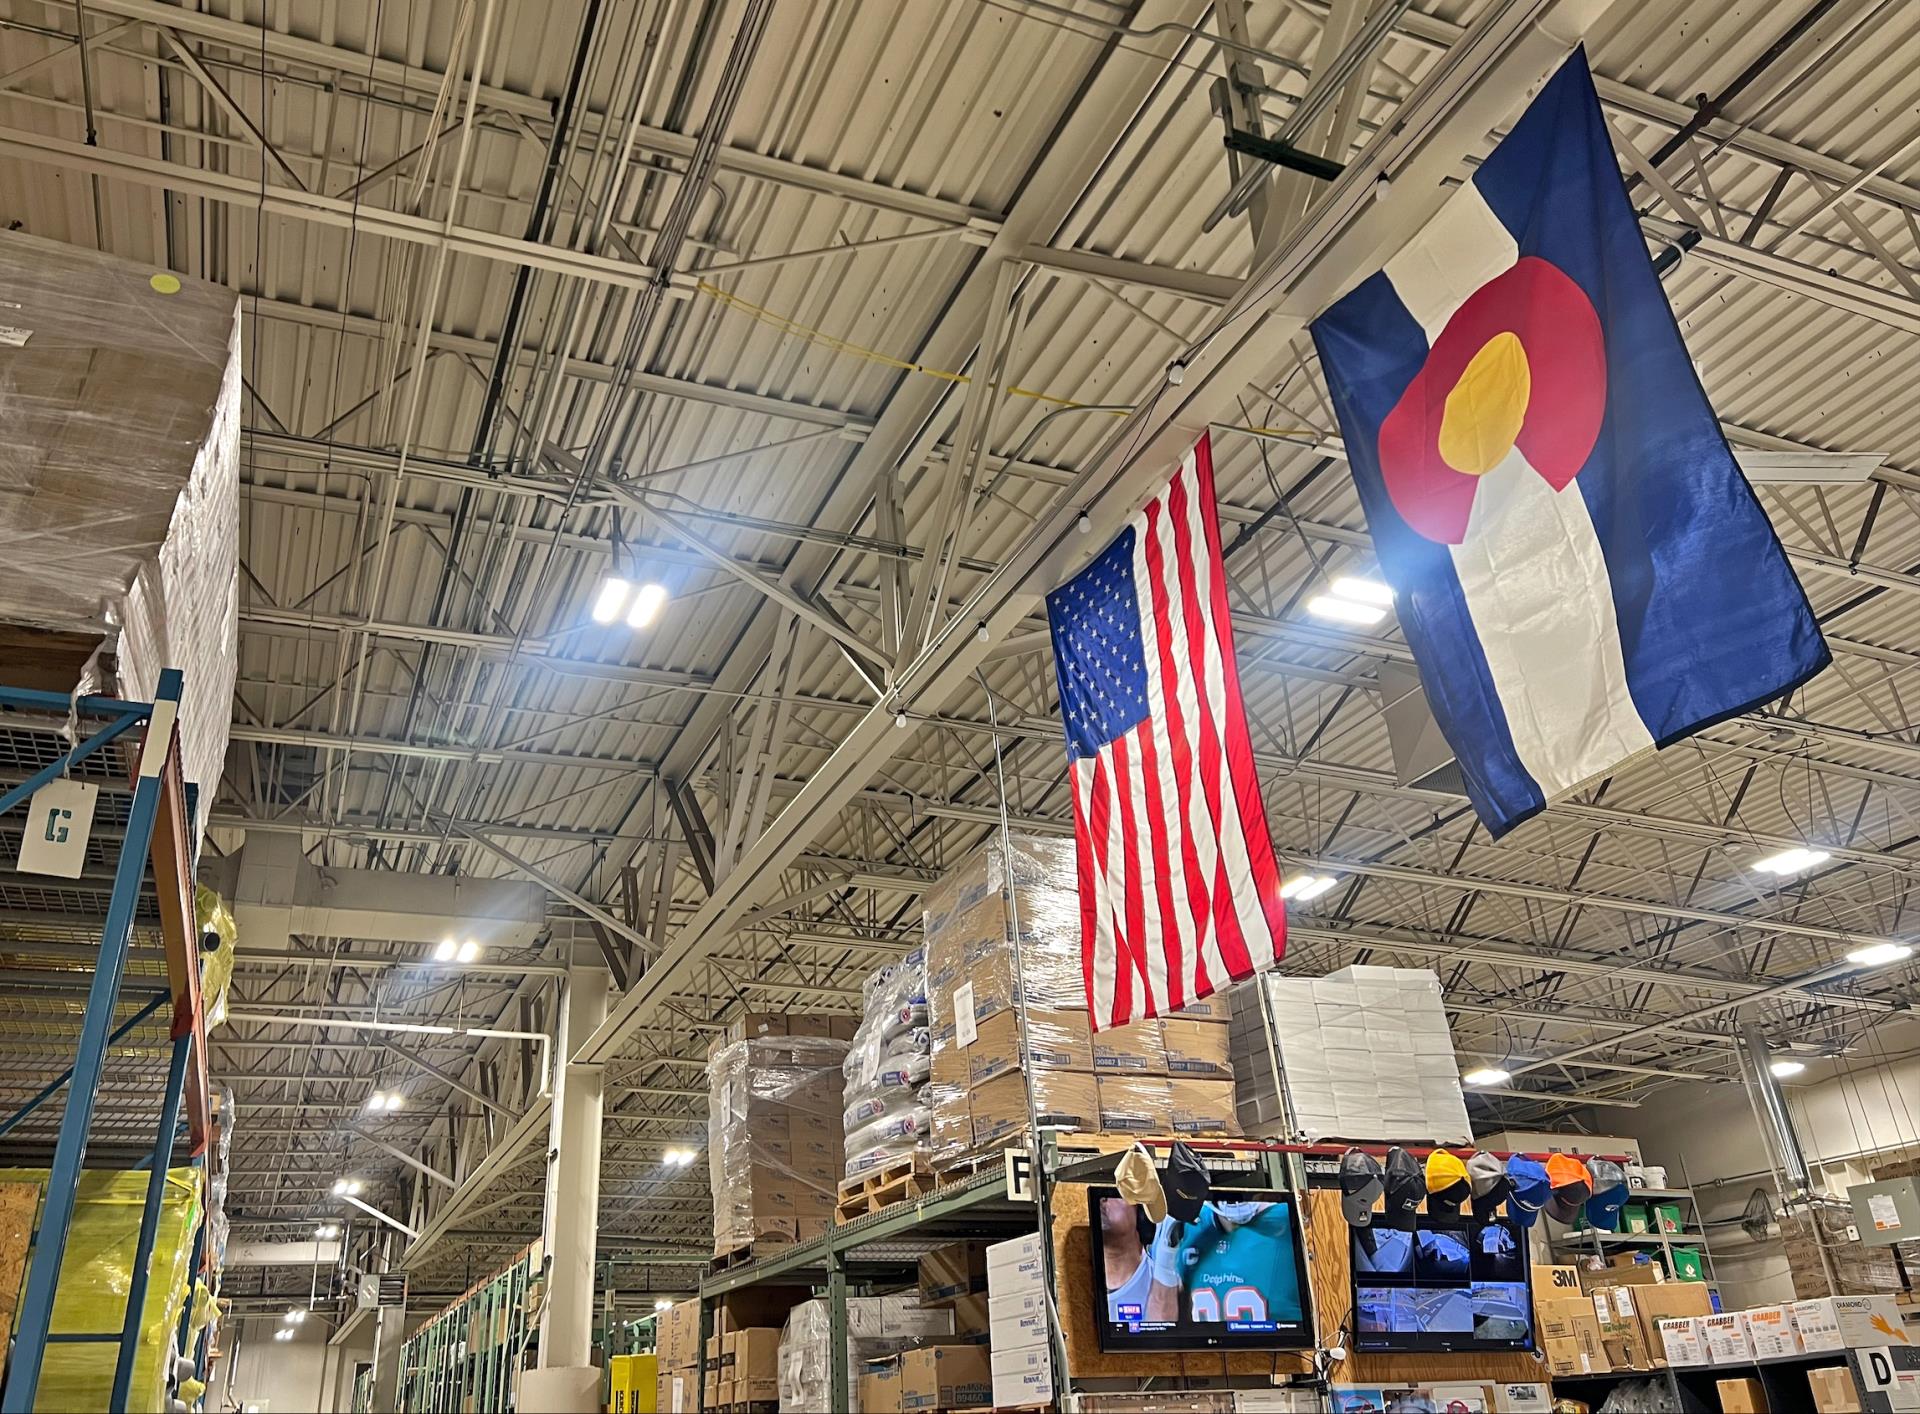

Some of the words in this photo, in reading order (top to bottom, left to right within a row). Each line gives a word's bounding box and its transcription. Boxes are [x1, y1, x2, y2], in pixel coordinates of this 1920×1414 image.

[44, 808, 71, 843] G
[1012, 1156, 1031, 1194] F
[1203, 1273, 1244, 1286] Dolphins
[1552, 1270, 1577, 1287] 3M
[1707, 1316, 1734, 1327] GRABBER
[1752, 1311, 1780, 1322] GRABBER
[1662, 1320, 1690, 1330] GRABBER
[1869, 1352, 1891, 1386] D
